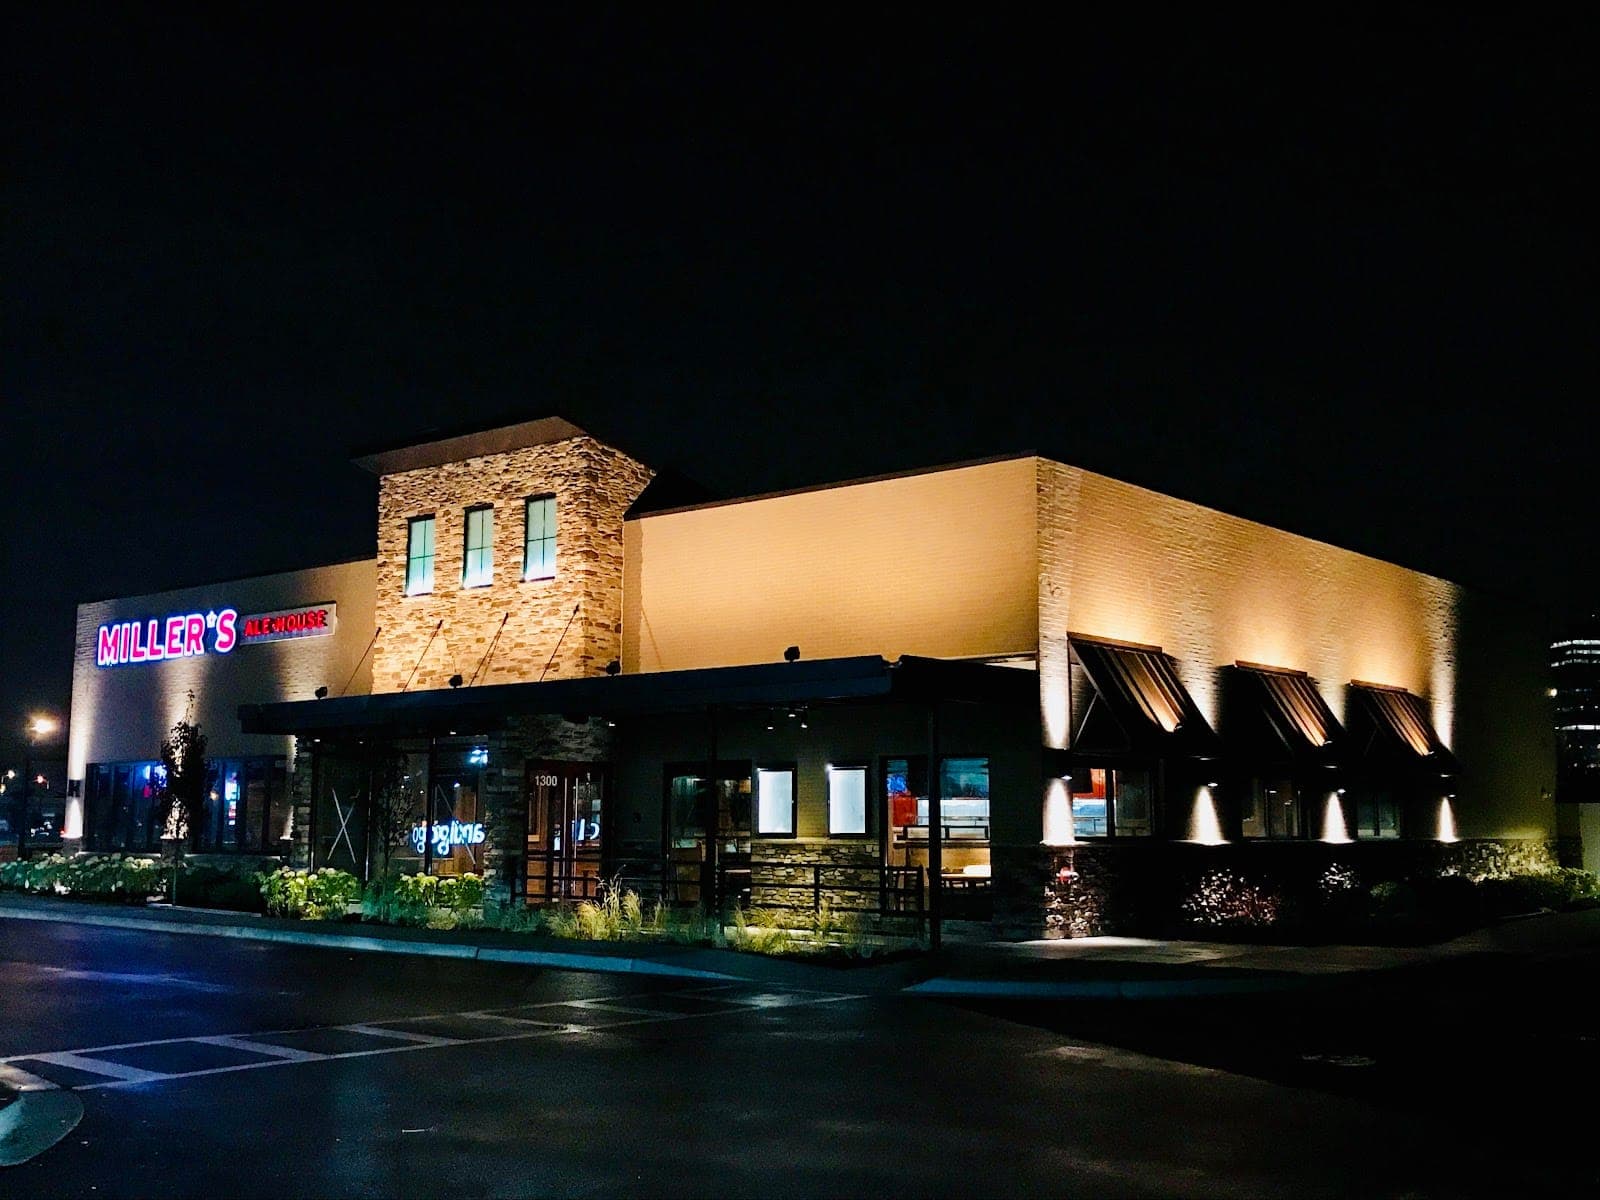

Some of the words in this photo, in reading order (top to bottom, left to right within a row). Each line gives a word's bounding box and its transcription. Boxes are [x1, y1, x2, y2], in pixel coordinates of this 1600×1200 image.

[244, 617, 271, 636] ALE
[275, 609, 327, 632] HOUSE
[98, 609, 237, 666] MILLER'S
[535, 775, 558, 787] 1300
